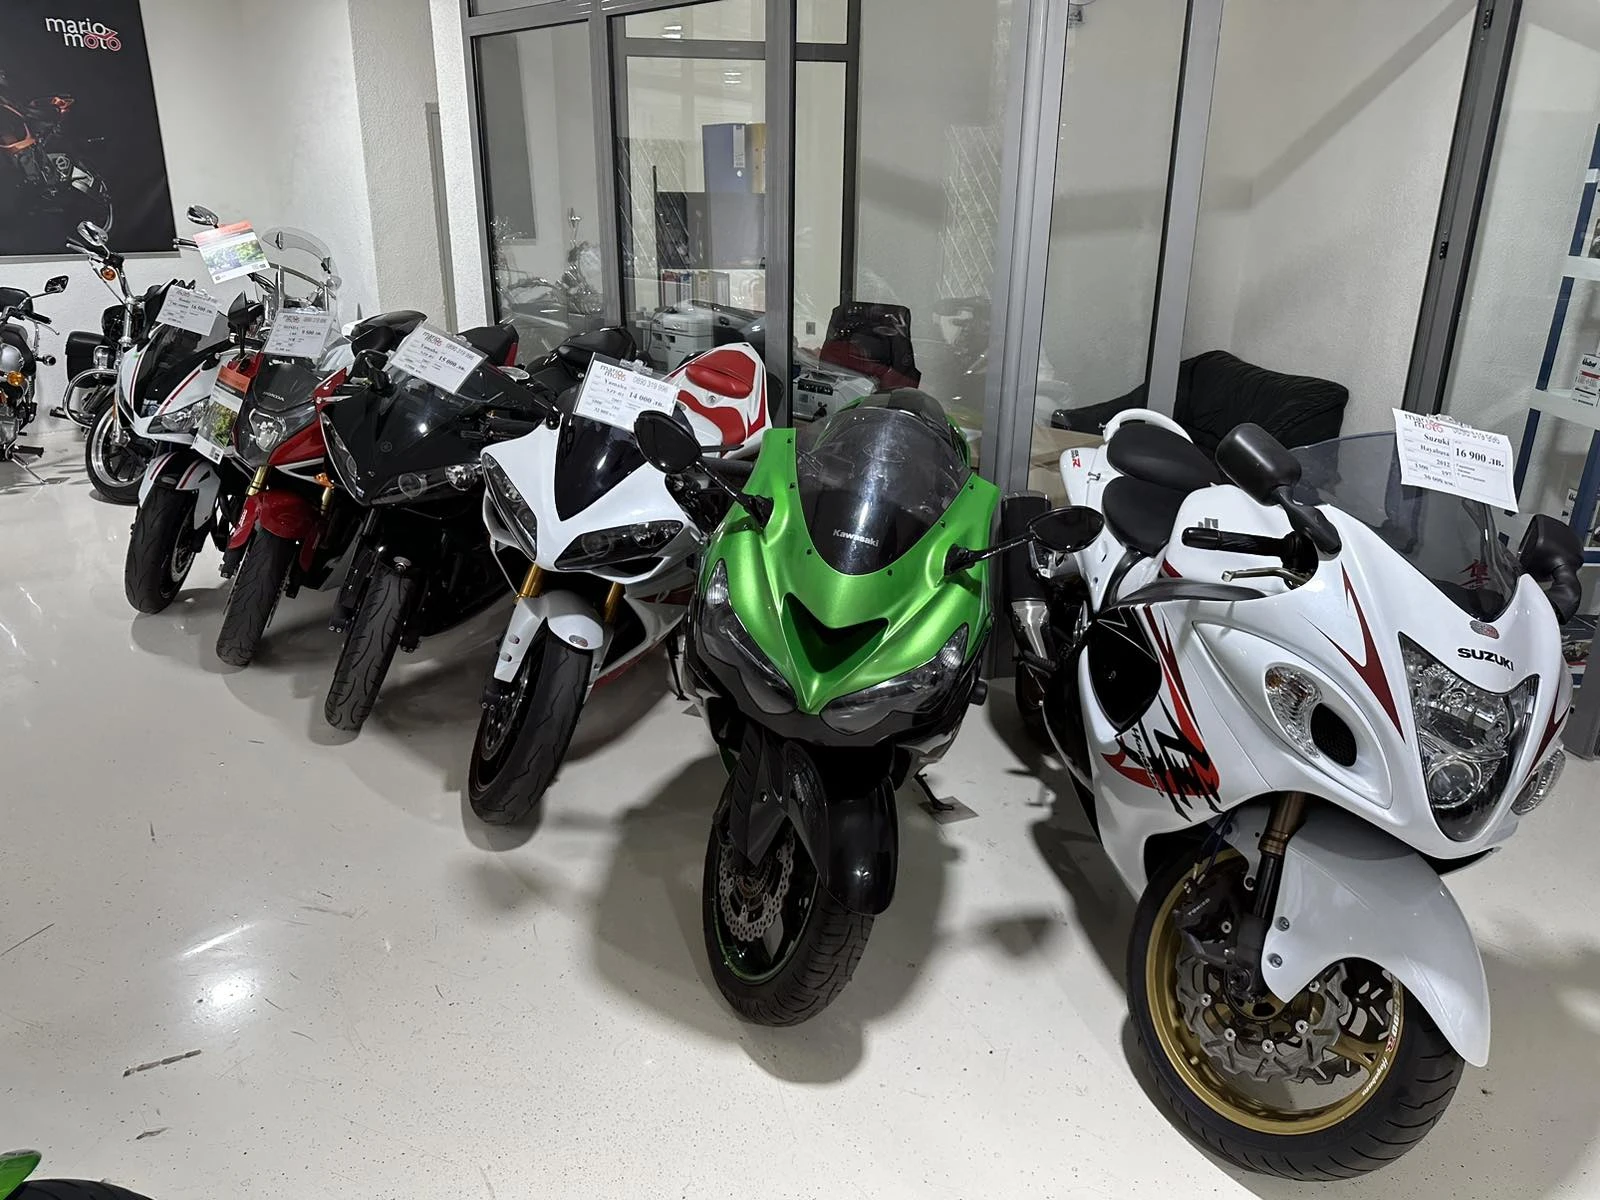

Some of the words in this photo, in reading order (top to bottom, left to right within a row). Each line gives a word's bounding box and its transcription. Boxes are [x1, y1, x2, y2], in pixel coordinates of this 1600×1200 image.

[45, 17, 106, 35] mario
[63, 33, 122, 52] moto
[600, 365, 624, 376] mario
[604, 370, 626, 382] moto
[262, 391, 285, 402] HONDA
[628, 391, 638, 399] 14
[639, 394, 652, 404] 000
[1414, 421, 1444, 433] moto
[1424, 433, 1450, 446] Suzuki
[1436, 459, 1451, 468] 2012
[1456, 447, 1467, 458] 16
[1469, 450, 1487, 463] 900
[1488, 458, 1505, 468] лв.
[832, 528, 880, 547] Kawasaki
[1457, 647, 1514, 671] SUZUKI
